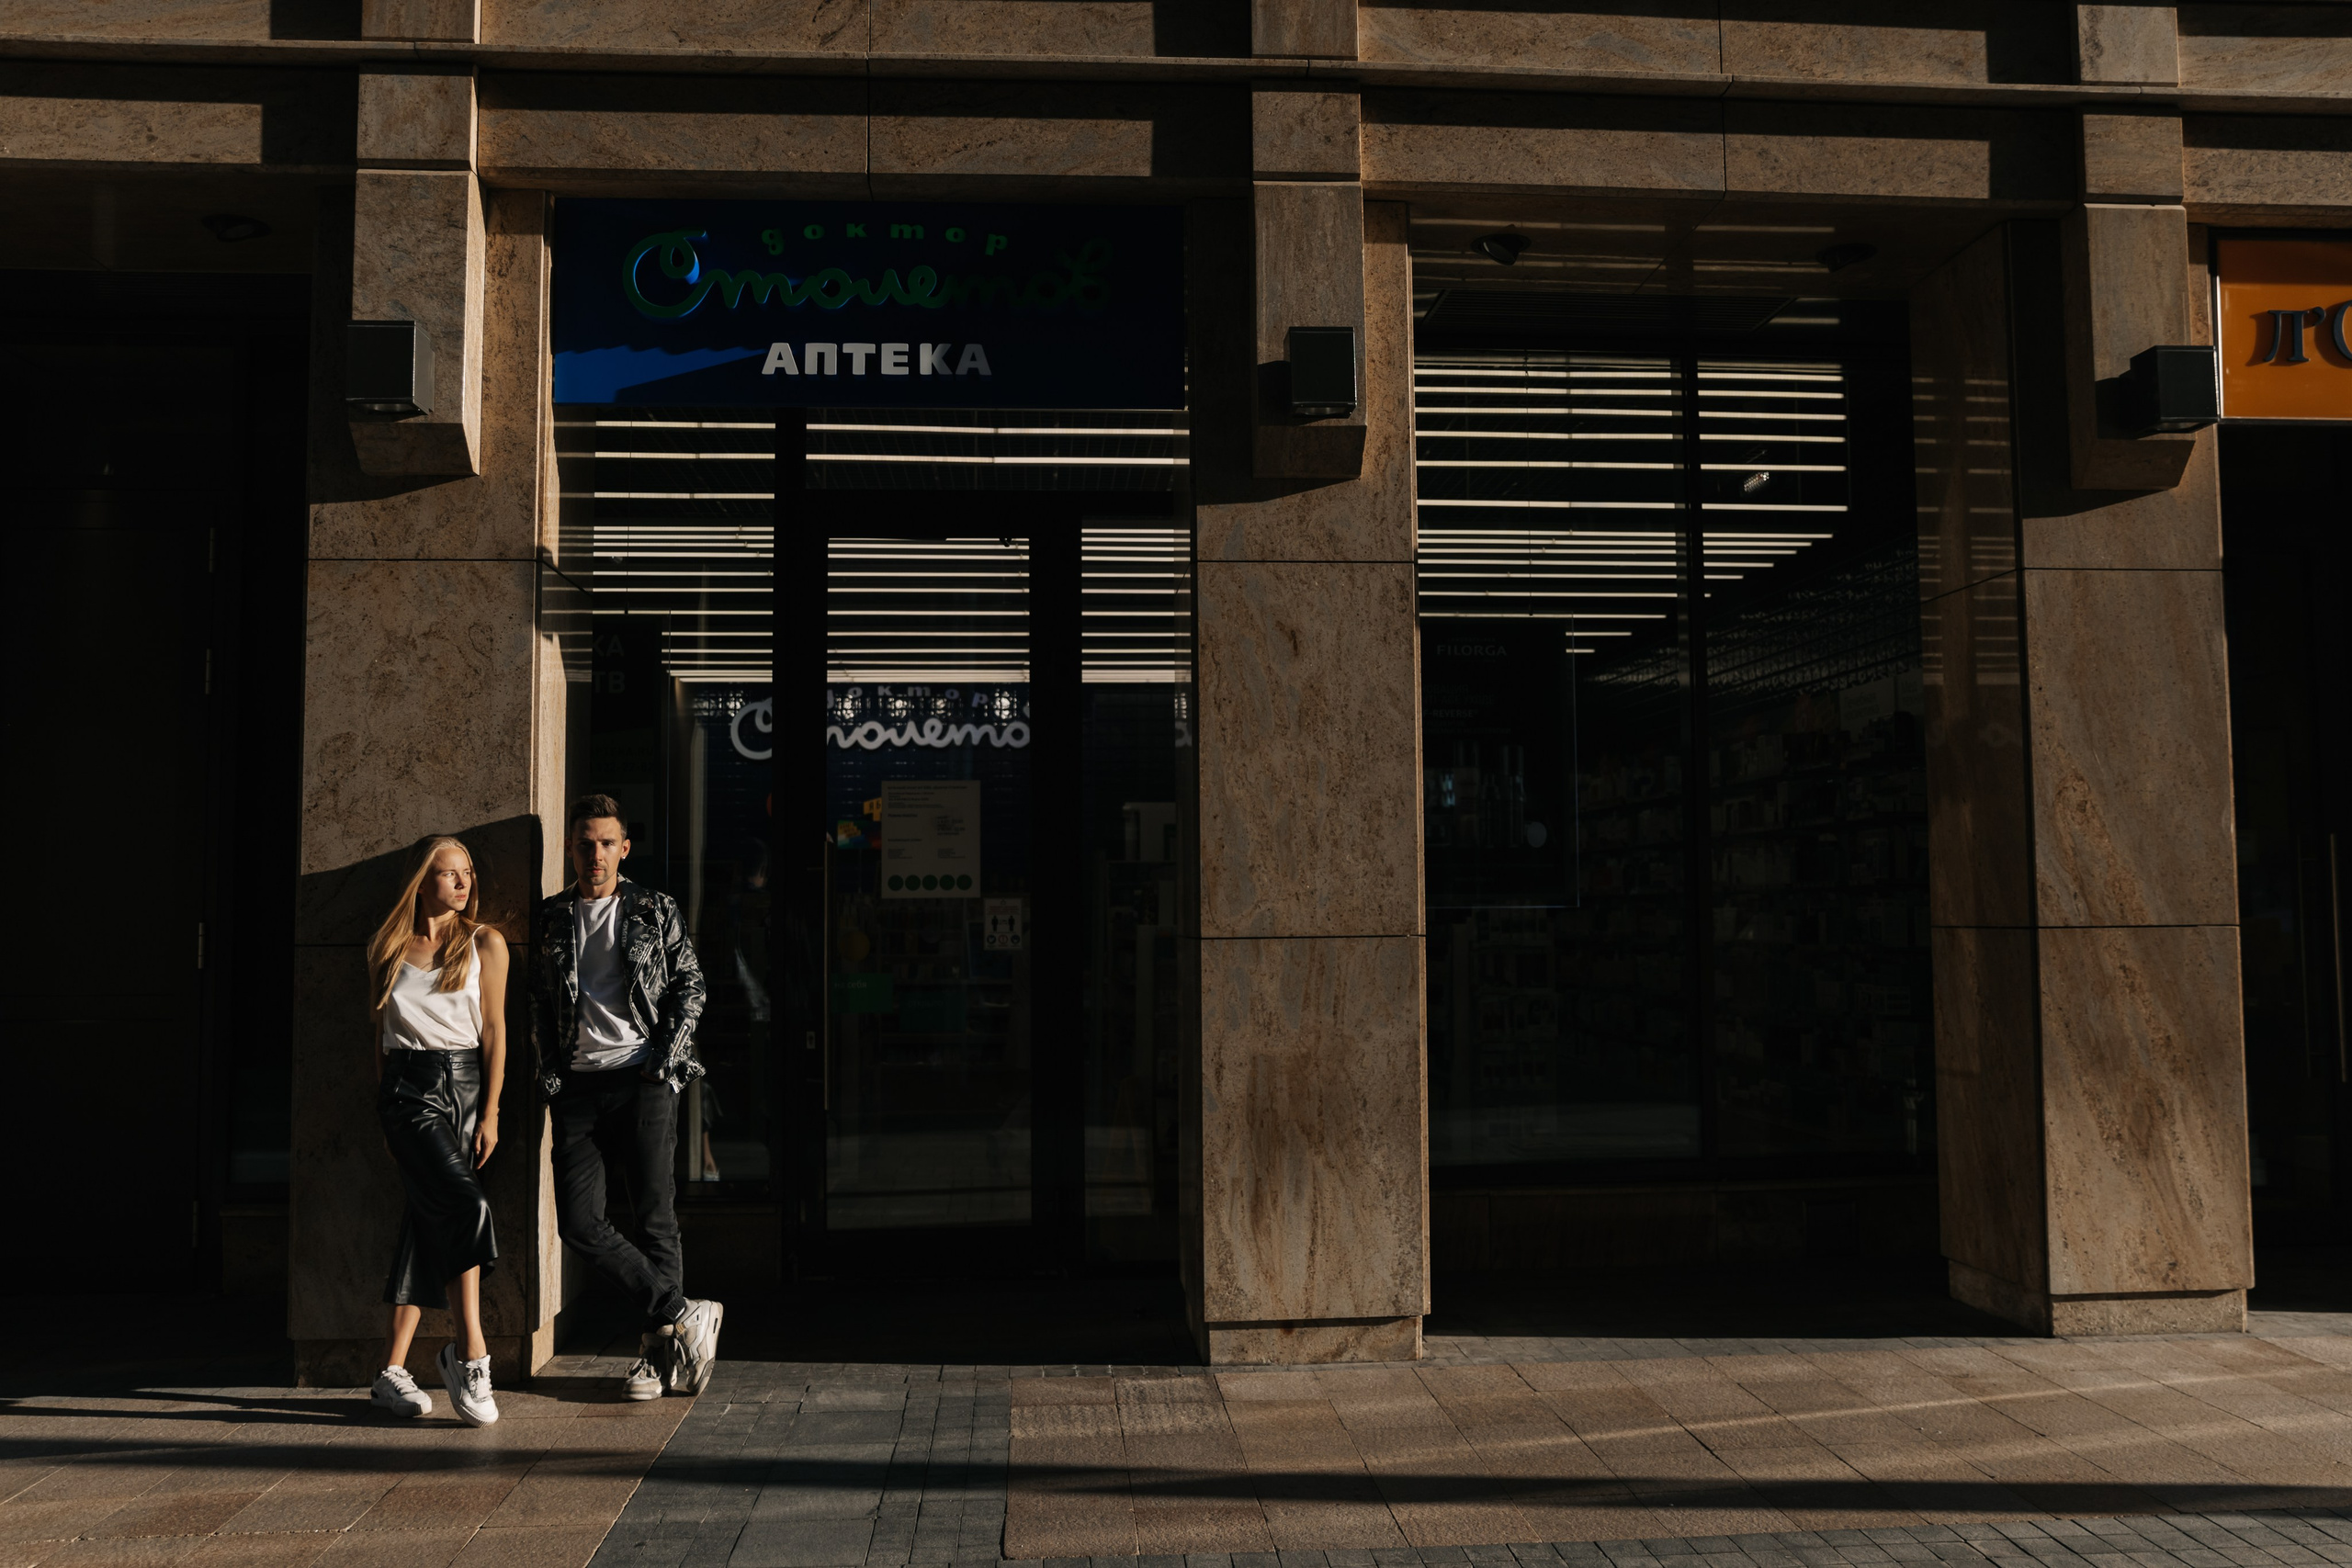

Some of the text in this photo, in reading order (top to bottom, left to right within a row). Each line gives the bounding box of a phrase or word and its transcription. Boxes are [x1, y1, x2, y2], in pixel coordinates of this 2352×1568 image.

[762, 223, 1008, 256] доктор
[762, 342, 992, 376] АПТЕКА
[1436, 645, 1508, 657] FILORGA
